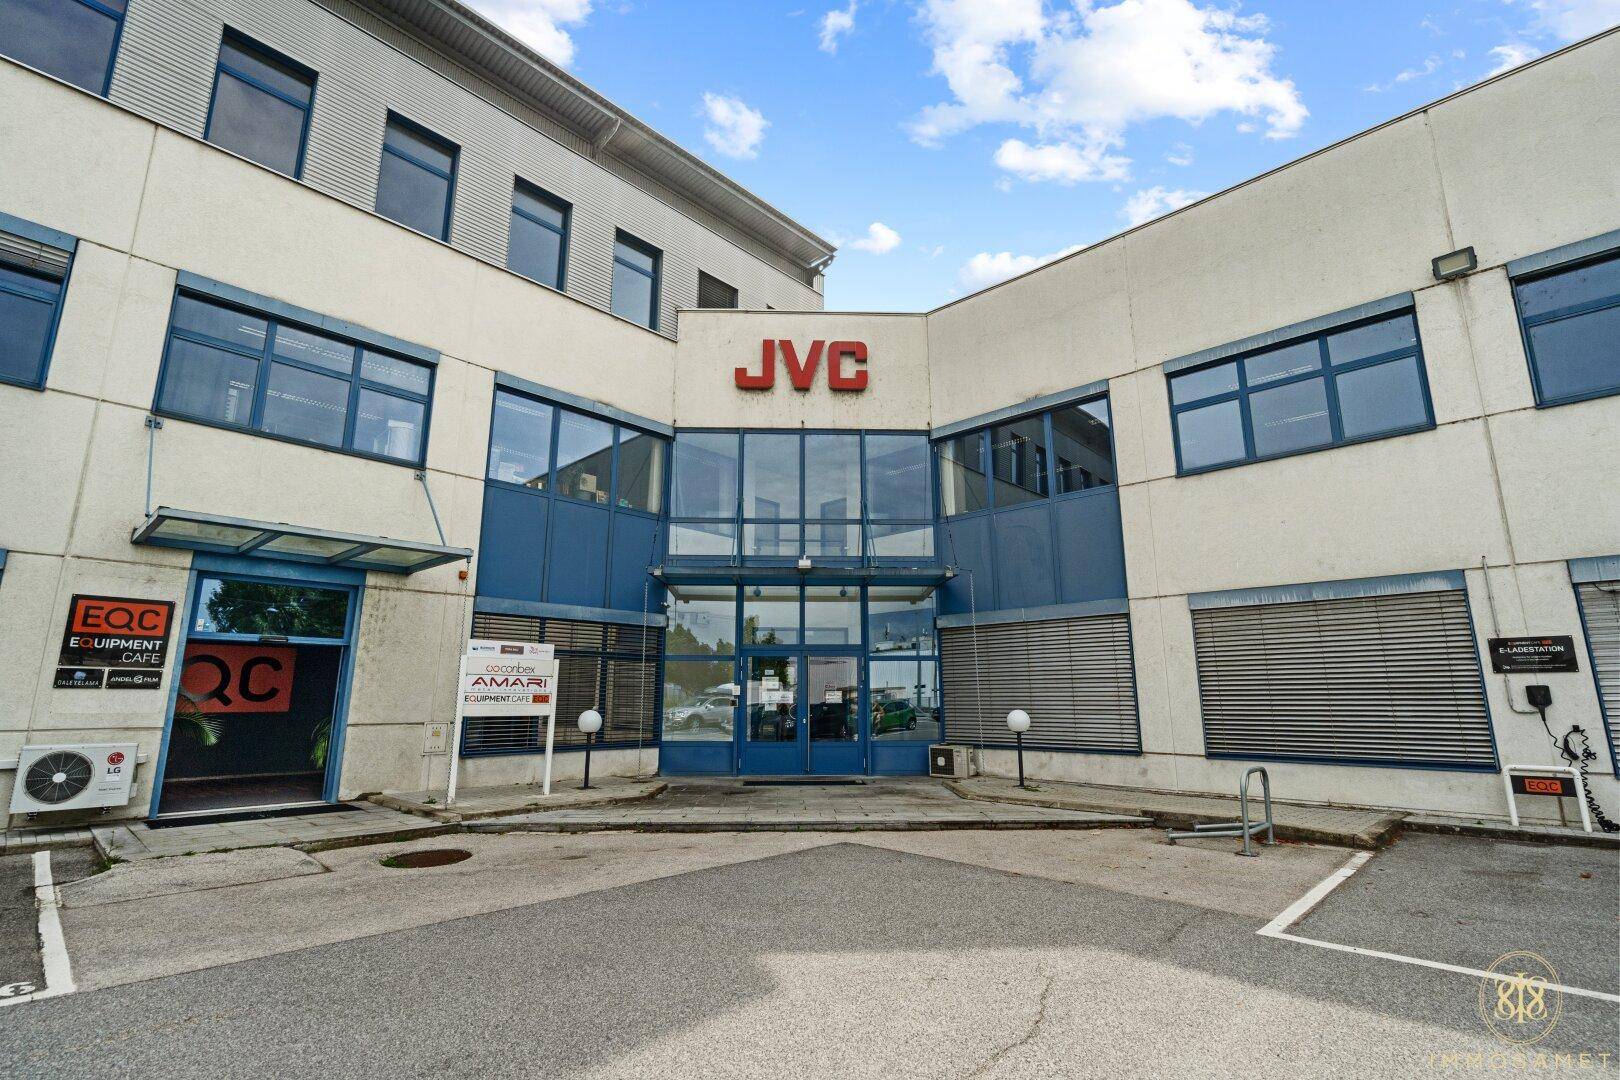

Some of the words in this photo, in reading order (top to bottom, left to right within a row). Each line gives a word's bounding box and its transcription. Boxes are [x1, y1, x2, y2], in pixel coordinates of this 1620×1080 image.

[735, 339, 869, 391] JVC
[81, 605, 160, 631] EQC
[69, 637, 163, 650] EQUIPMENT
[1498, 645, 1565, 654] E-LADESTATION
[119, 652, 161, 664] .CAFE
[472, 676, 547, 688] AMARI
[464, 694, 530, 703] EQUIPMENT.CAFE
[107, 766, 121, 774] LG
[1528, 780, 1559, 792] EQC
